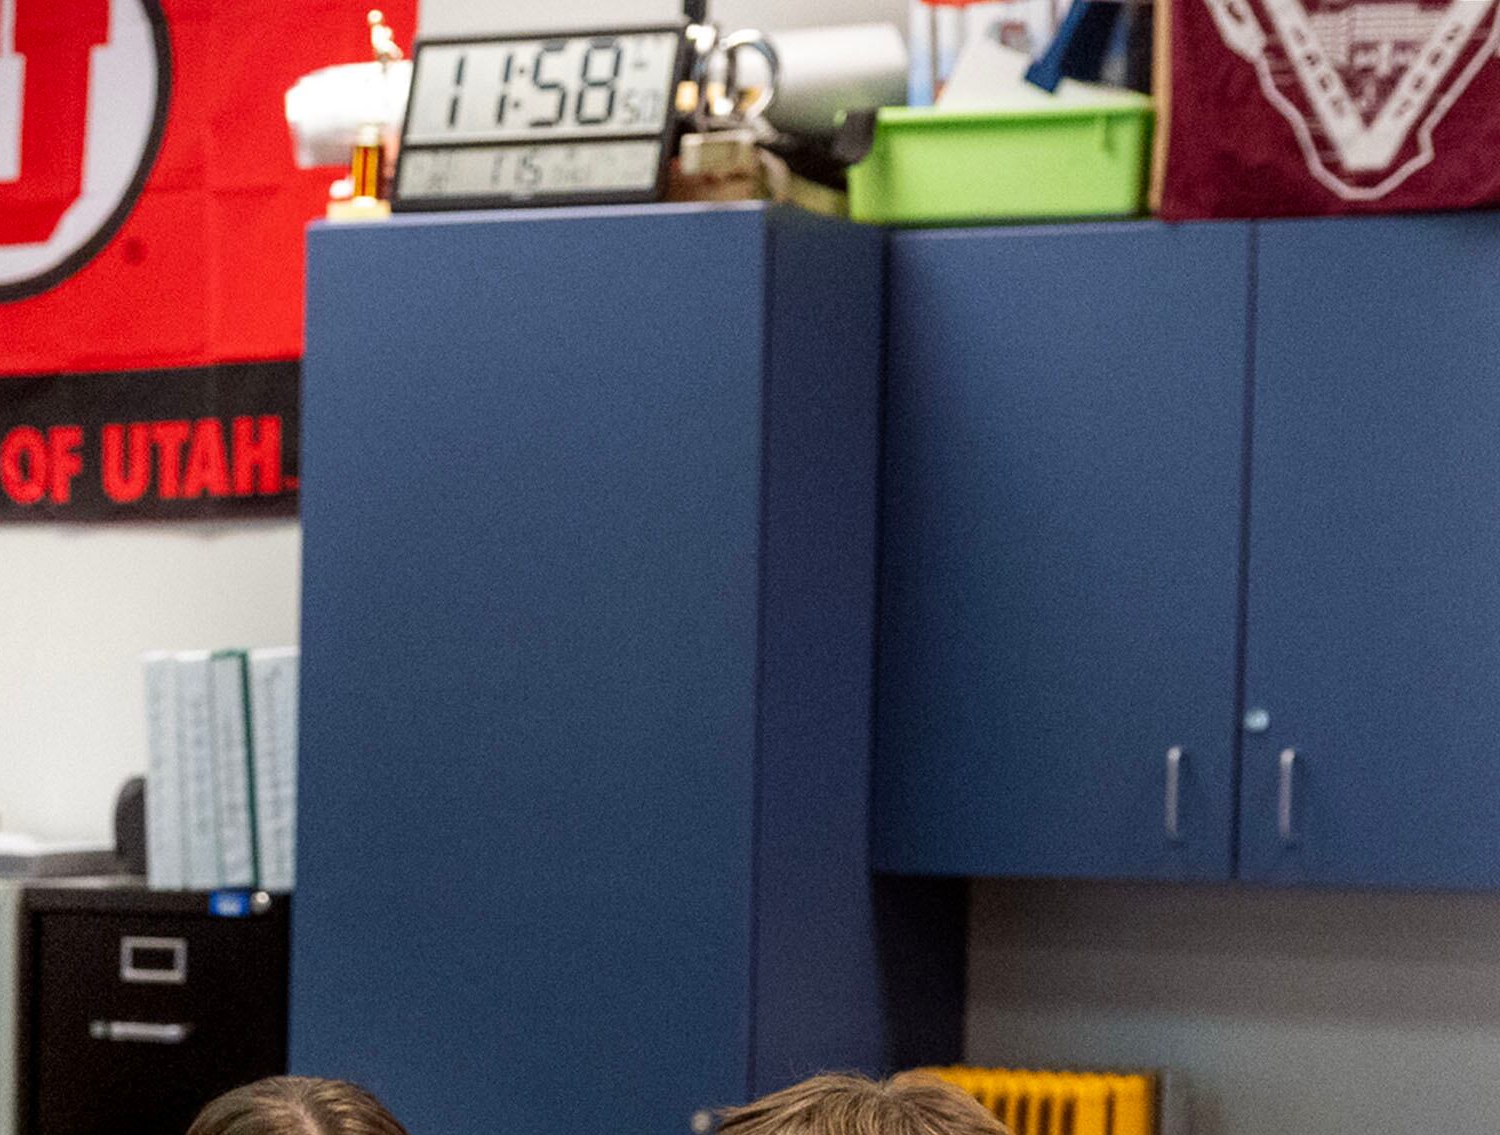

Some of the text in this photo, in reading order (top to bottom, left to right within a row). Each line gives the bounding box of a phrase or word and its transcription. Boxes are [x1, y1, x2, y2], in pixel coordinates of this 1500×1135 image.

[448, 36, 622, 128] 11:58
[0, 425, 85, 506] OF
[102, 414, 283, 503] UTAH
